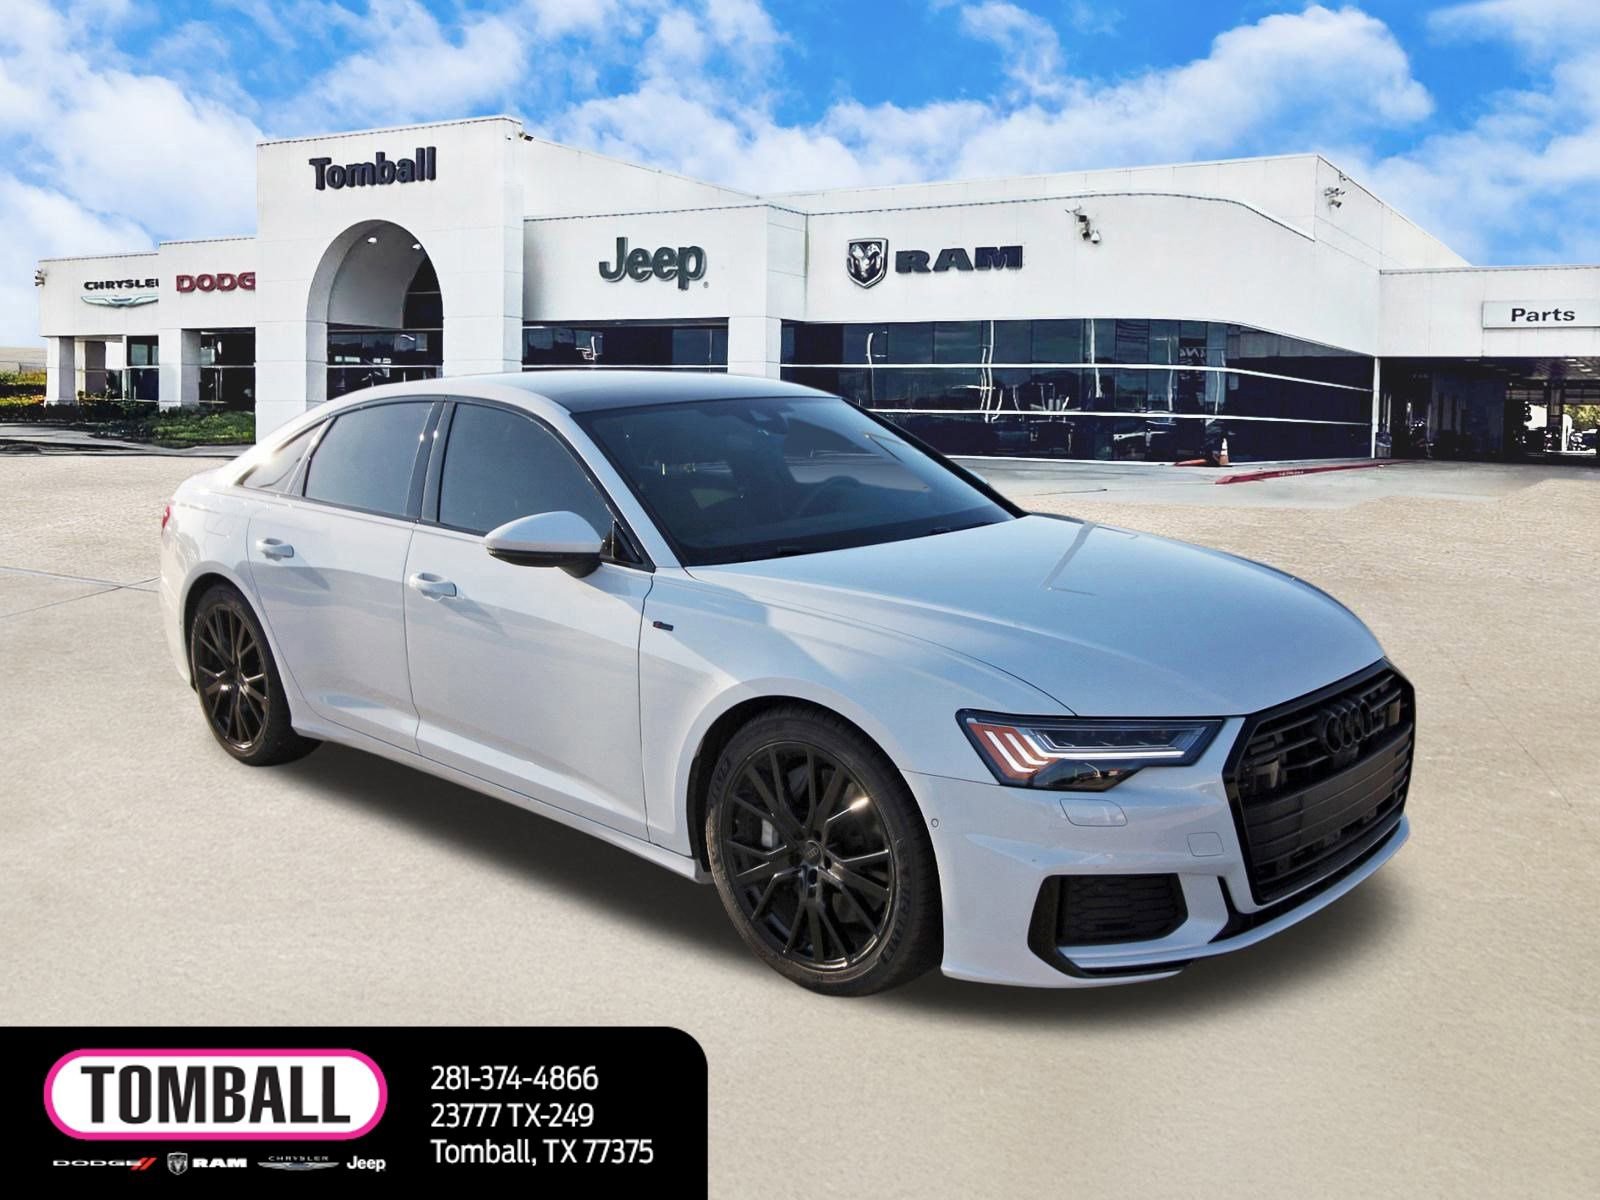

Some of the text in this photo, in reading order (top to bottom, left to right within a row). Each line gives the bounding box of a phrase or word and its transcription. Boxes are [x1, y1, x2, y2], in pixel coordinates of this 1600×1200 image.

[309, 147, 437, 191] Tomball
[599, 237, 707, 290] Jeep
[895, 245, 1024, 274] RAM
[1511, 307, 1576, 323] Parts
